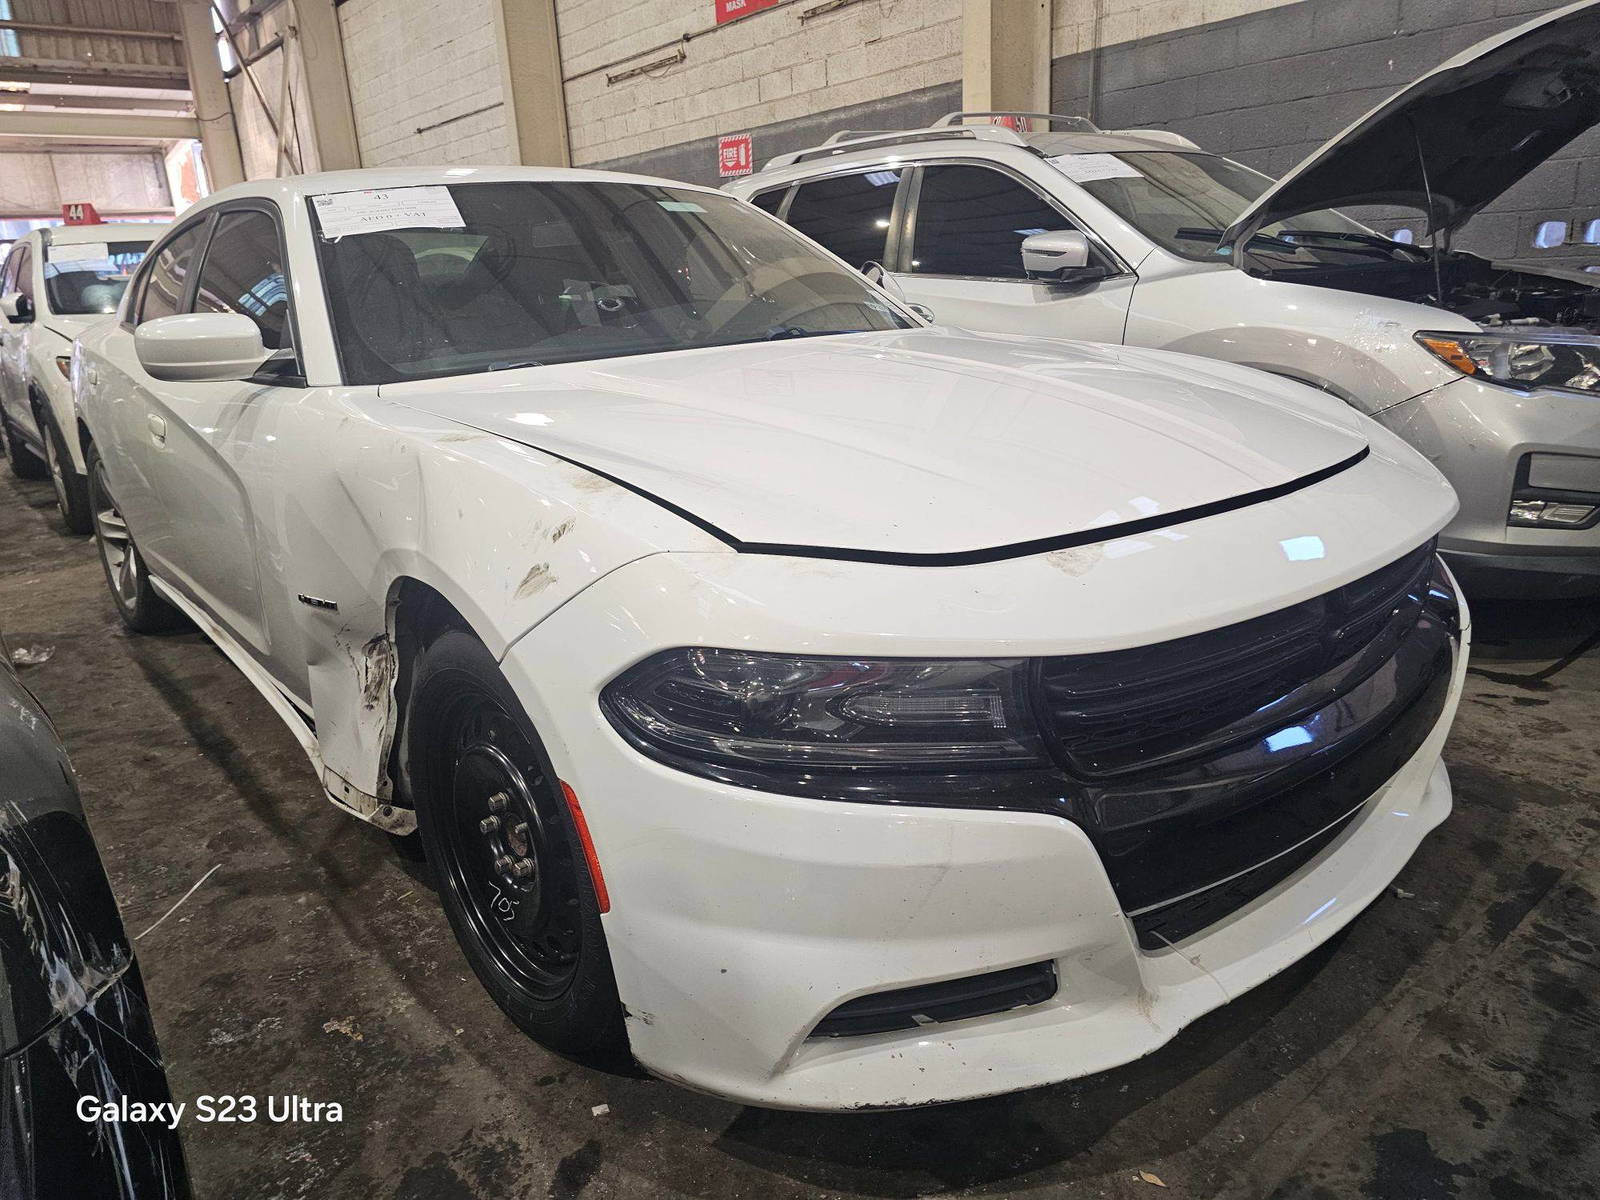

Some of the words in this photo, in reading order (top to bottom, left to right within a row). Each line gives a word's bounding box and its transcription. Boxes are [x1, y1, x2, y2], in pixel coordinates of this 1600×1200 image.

[726, 0, 746, 12] MASK
[723, 147, 738, 159] FIRE
[69, 204, 84, 220] 44
